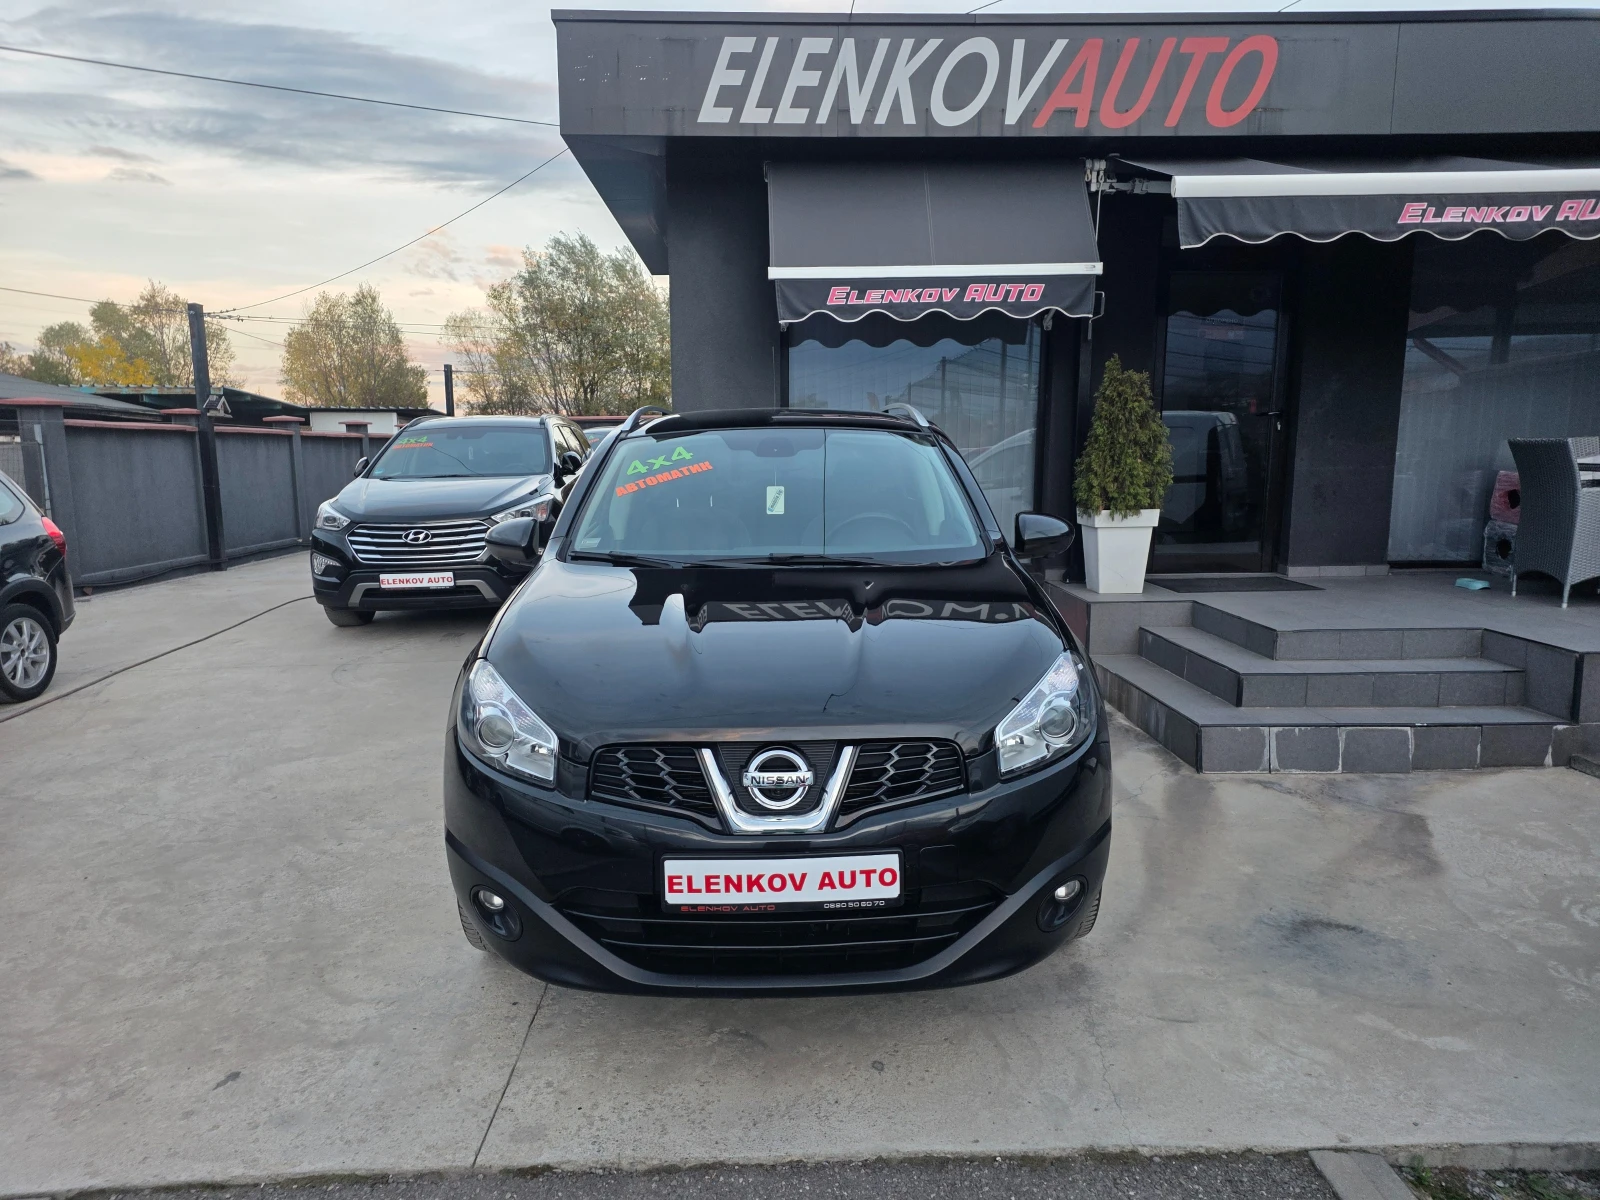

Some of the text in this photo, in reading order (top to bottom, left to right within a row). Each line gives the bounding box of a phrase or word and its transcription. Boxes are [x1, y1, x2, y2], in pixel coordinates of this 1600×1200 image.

[697, 35, 1279, 129] ELENKOV AUTO
[963, 283, 1045, 302] AUTO
[380, 576, 453, 585] ELENKOV AUTO
[750, 775, 806, 785] NISSAN
[667, 867, 898, 894] ELENKOV AUTO
